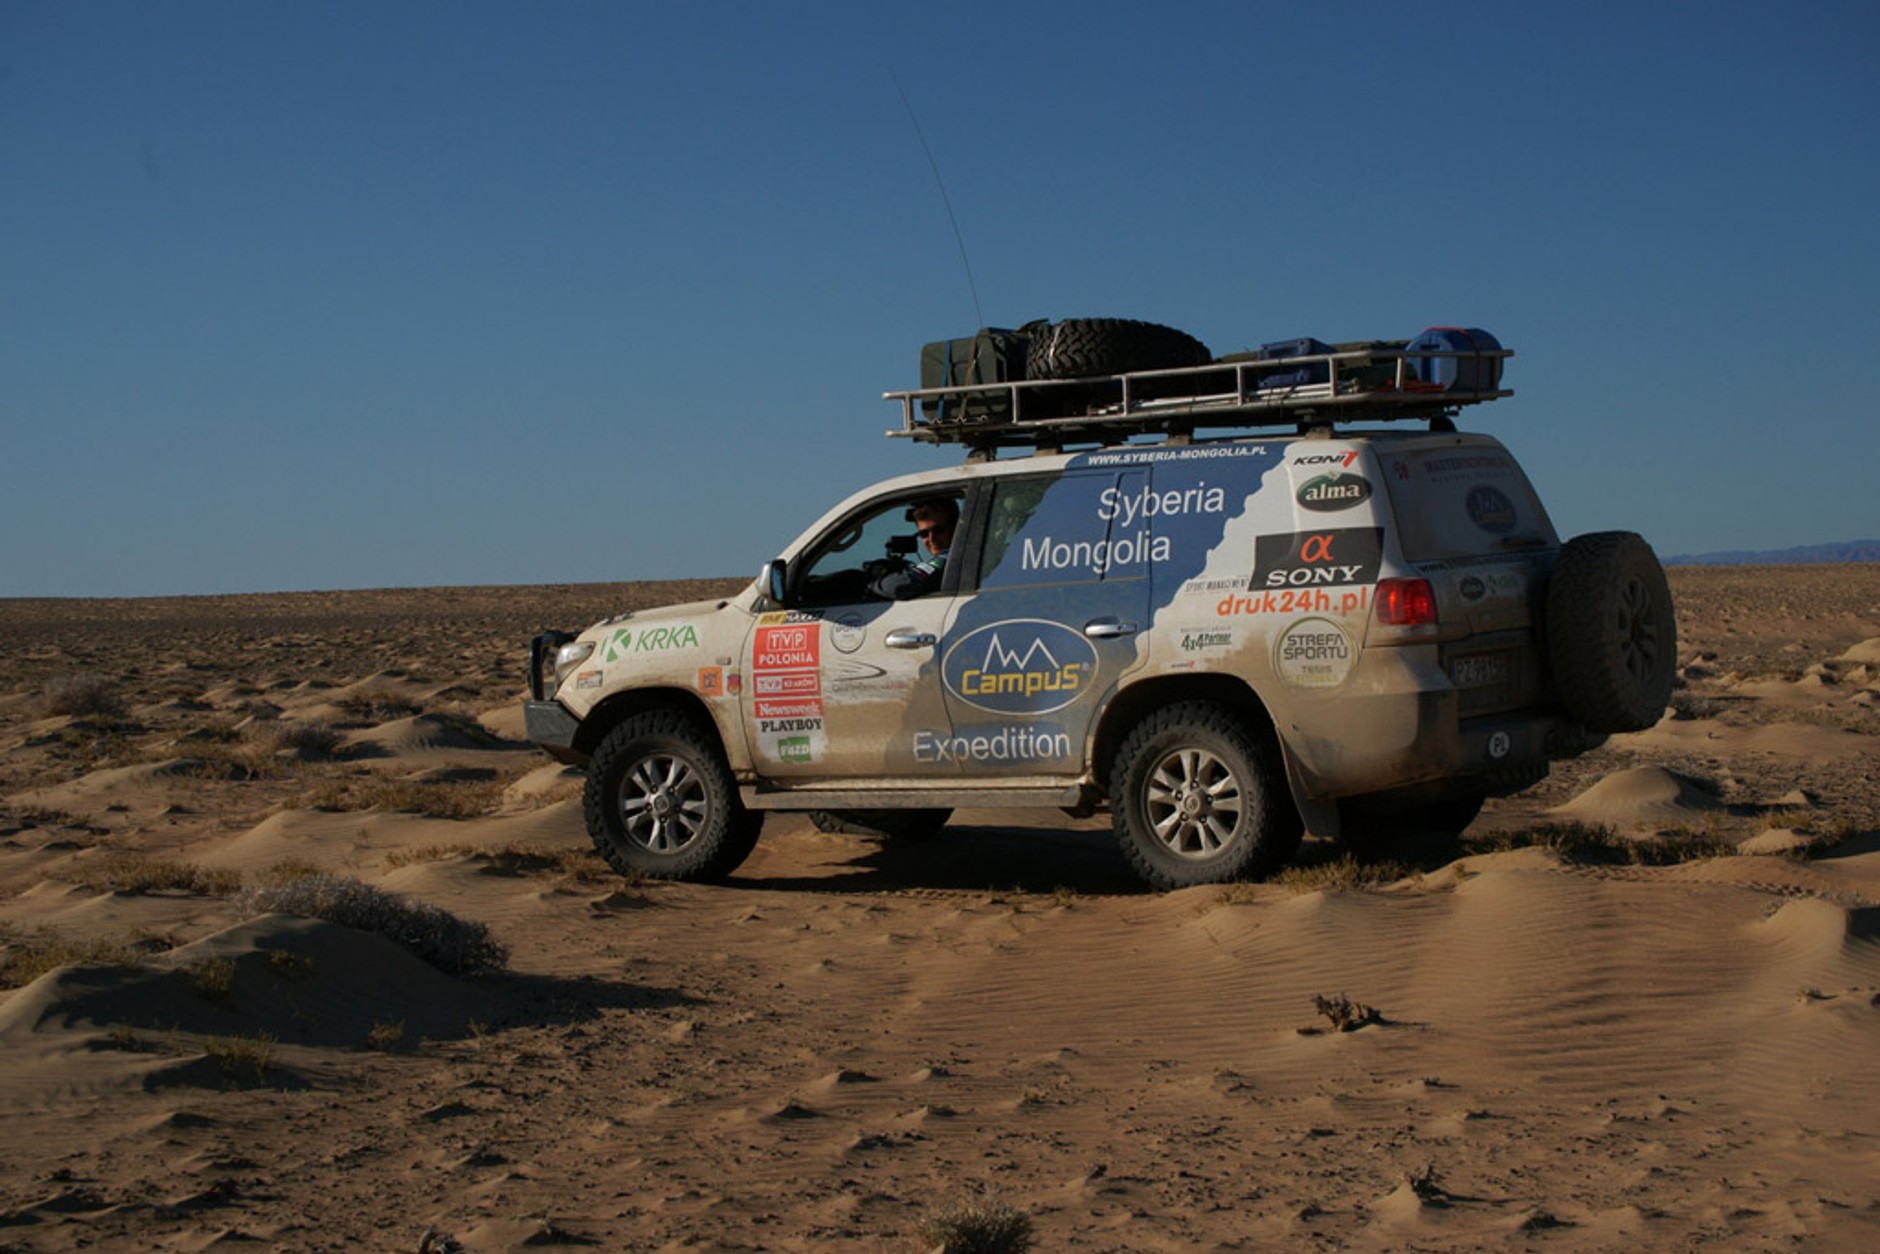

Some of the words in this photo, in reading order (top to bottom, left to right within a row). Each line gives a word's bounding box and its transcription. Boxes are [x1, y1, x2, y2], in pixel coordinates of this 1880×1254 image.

[1088, 446, 1267, 466] WWW.SYBERIA-MONGOLIA.PL
[1304, 483, 1362, 500] alma
[1097, 481, 1225, 527] Syberia
[1022, 530, 1171, 574] Mongolia
[1266, 565, 1363, 586] SONY
[1217, 586, 1367, 617] druk24h.pl
[635, 624, 699, 653] KRKA
[769, 631, 805, 649] TVP
[1287, 633, 1345, 647] STREFA
[759, 652, 814, 665] POLONIA
[1283, 646, 1348, 660] SPORTU
[759, 701, 820, 716] Newsweek
[761, 718, 822, 732] PLAYBOY
